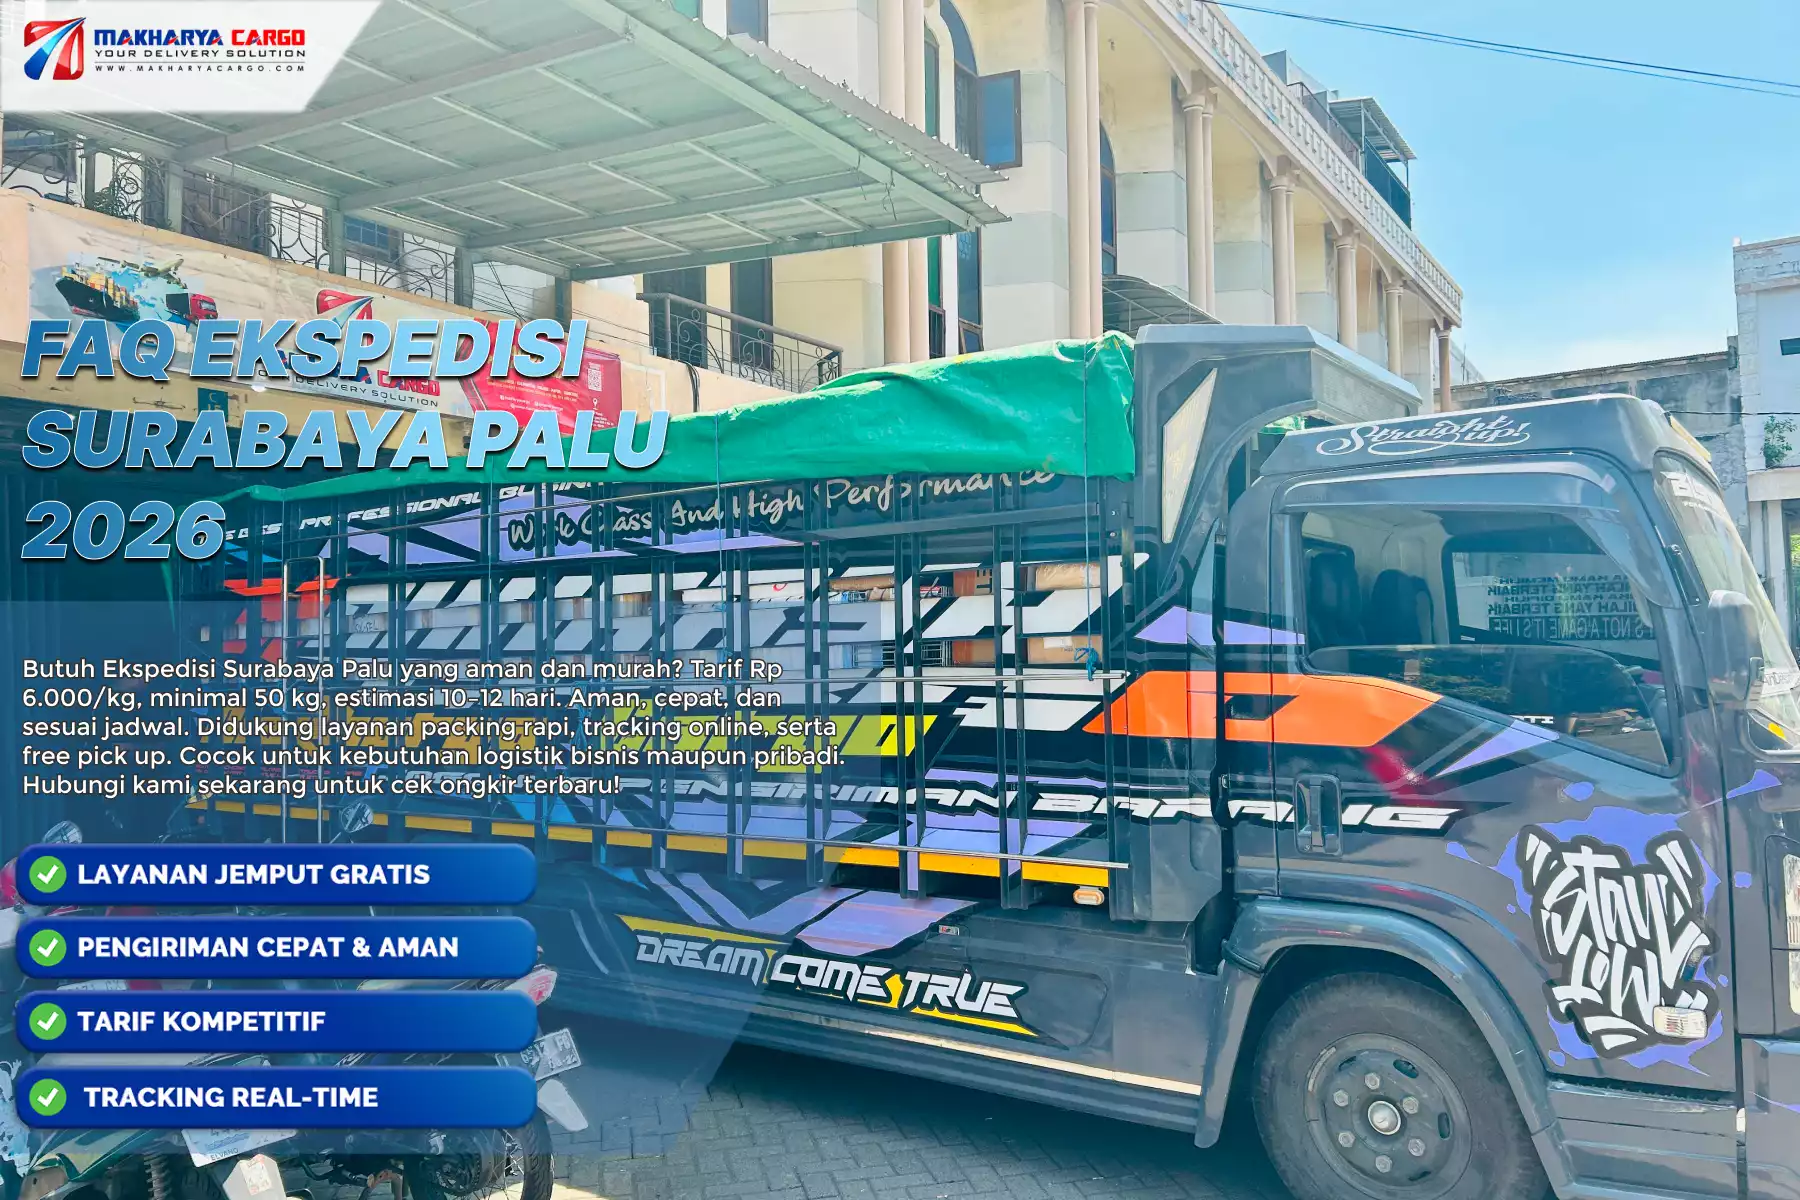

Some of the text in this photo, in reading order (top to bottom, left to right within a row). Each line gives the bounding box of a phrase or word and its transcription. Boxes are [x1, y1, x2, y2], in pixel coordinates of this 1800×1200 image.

[295, 375, 367, 395] DELIVERY
[371, 388, 439, 408] SOLUTION
[299, 491, 483, 530] PRFESSIONAL
[581, 510, 653, 536] Cass
[636, 934, 764, 986] DREAM
[903, 968, 1025, 1018] TRUE
